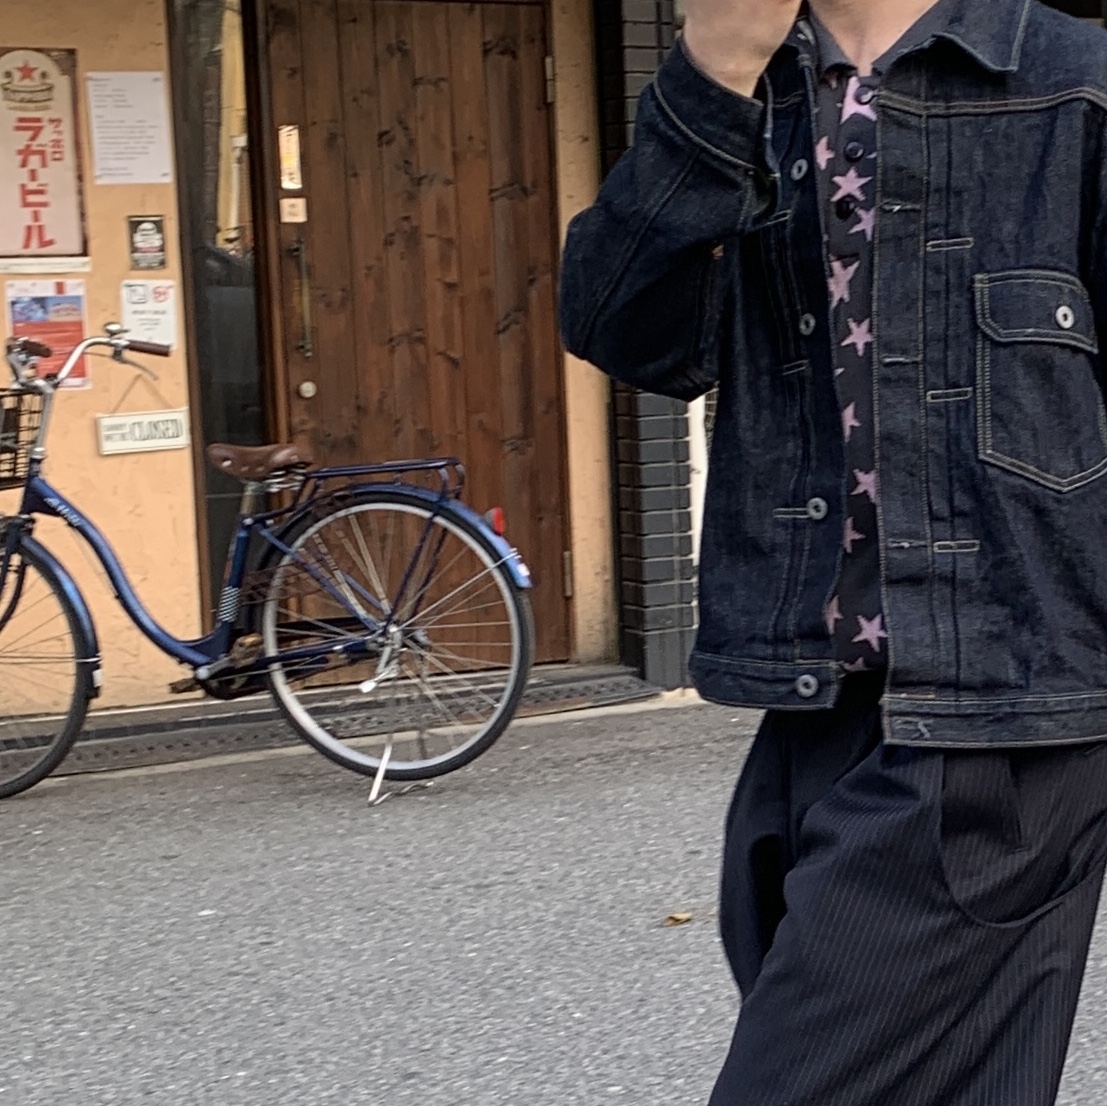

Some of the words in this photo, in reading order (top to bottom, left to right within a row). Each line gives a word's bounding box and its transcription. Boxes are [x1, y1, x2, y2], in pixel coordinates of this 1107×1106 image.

[13, 117, 56, 249] ラガービール
[48, 117, 64, 161] サッポロ
